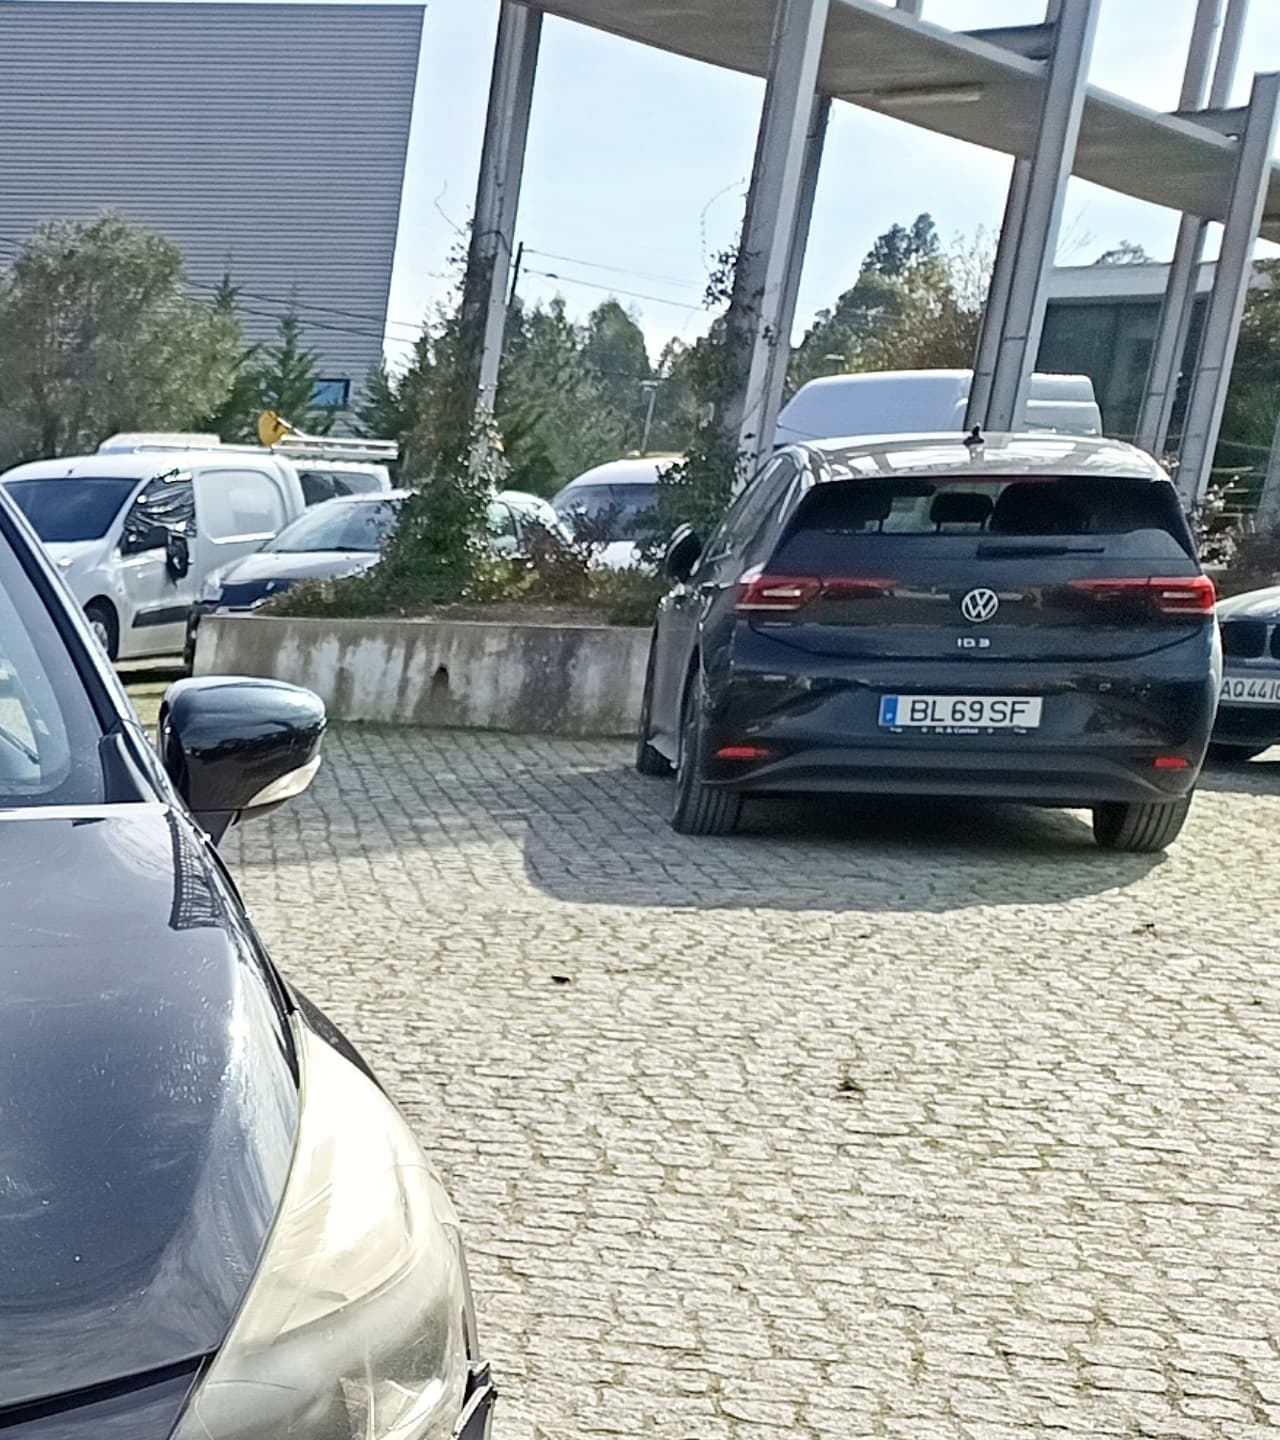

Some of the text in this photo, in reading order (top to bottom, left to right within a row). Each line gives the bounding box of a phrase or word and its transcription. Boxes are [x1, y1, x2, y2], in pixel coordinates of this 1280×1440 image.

[910, 700, 1030, 723] BL 69 SF
